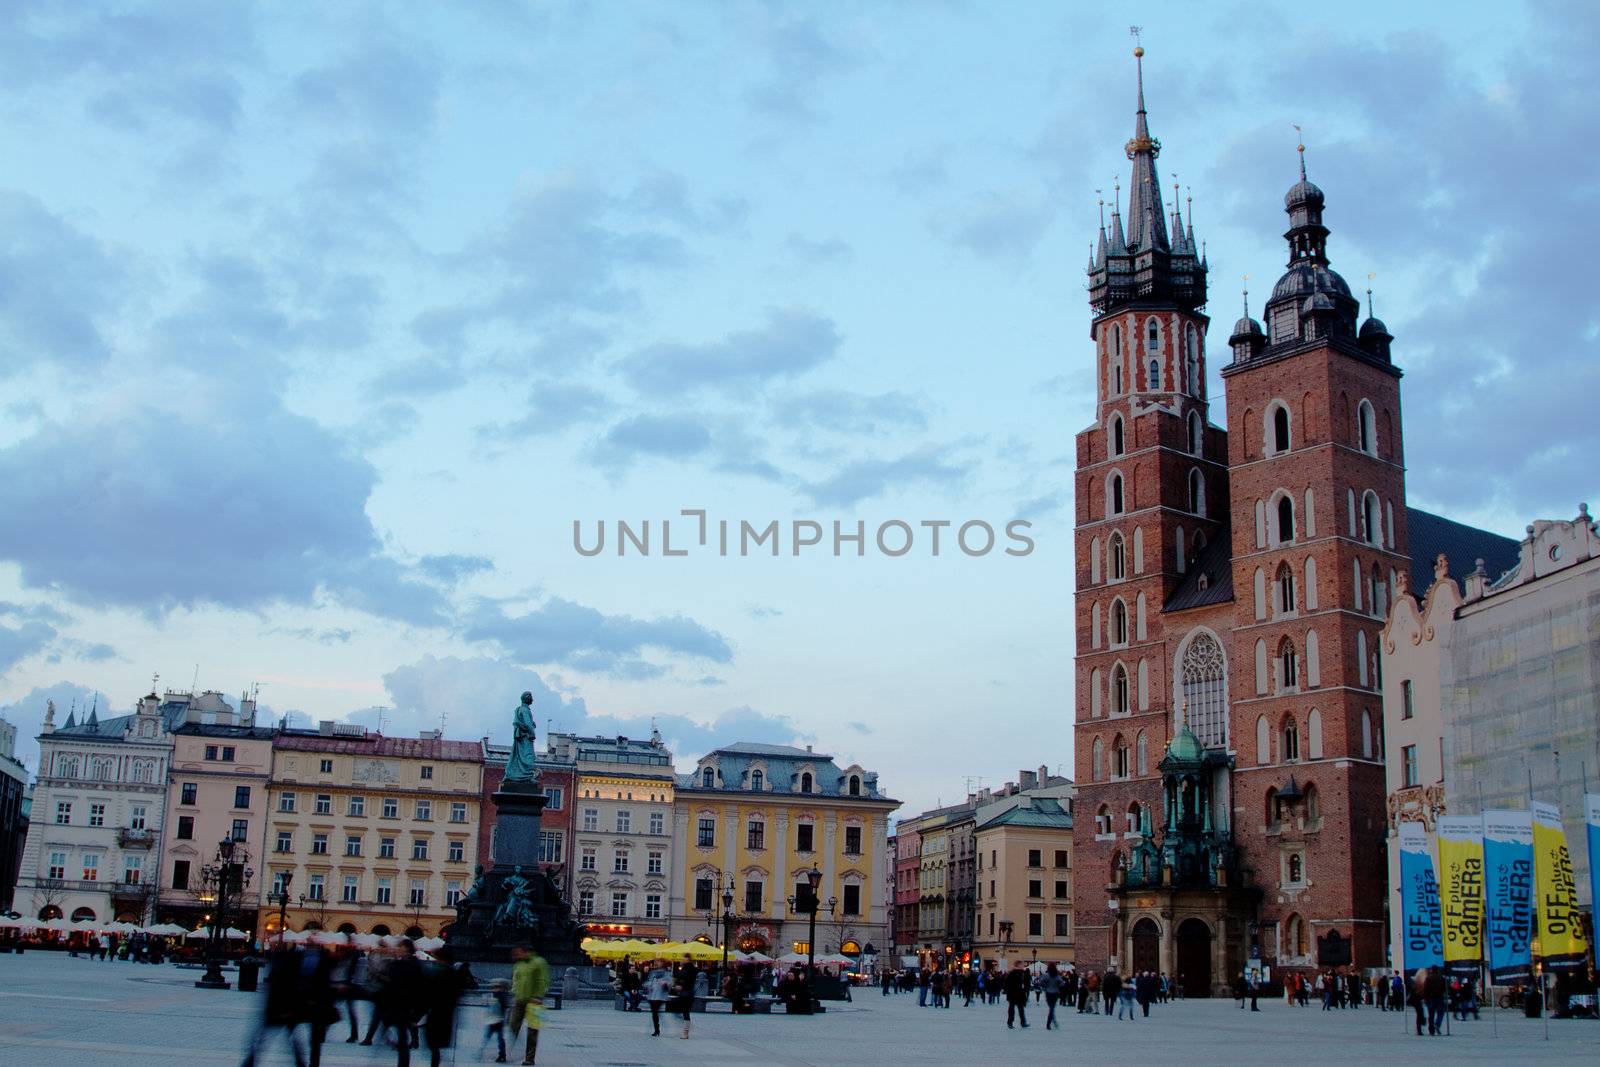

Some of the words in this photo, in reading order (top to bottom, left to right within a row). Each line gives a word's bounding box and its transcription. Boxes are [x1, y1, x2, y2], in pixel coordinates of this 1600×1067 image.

[1449, 874, 1461, 903] plus
[1496, 875, 1512, 907] plus
[1552, 862, 1567, 892] plus
[1414, 882, 1428, 913] plus
[1546, 894, 1569, 935] OFF
[1409, 914, 1430, 951] OFF
[1446, 904, 1462, 942] OFF
[1491, 908, 1512, 948] OFF
